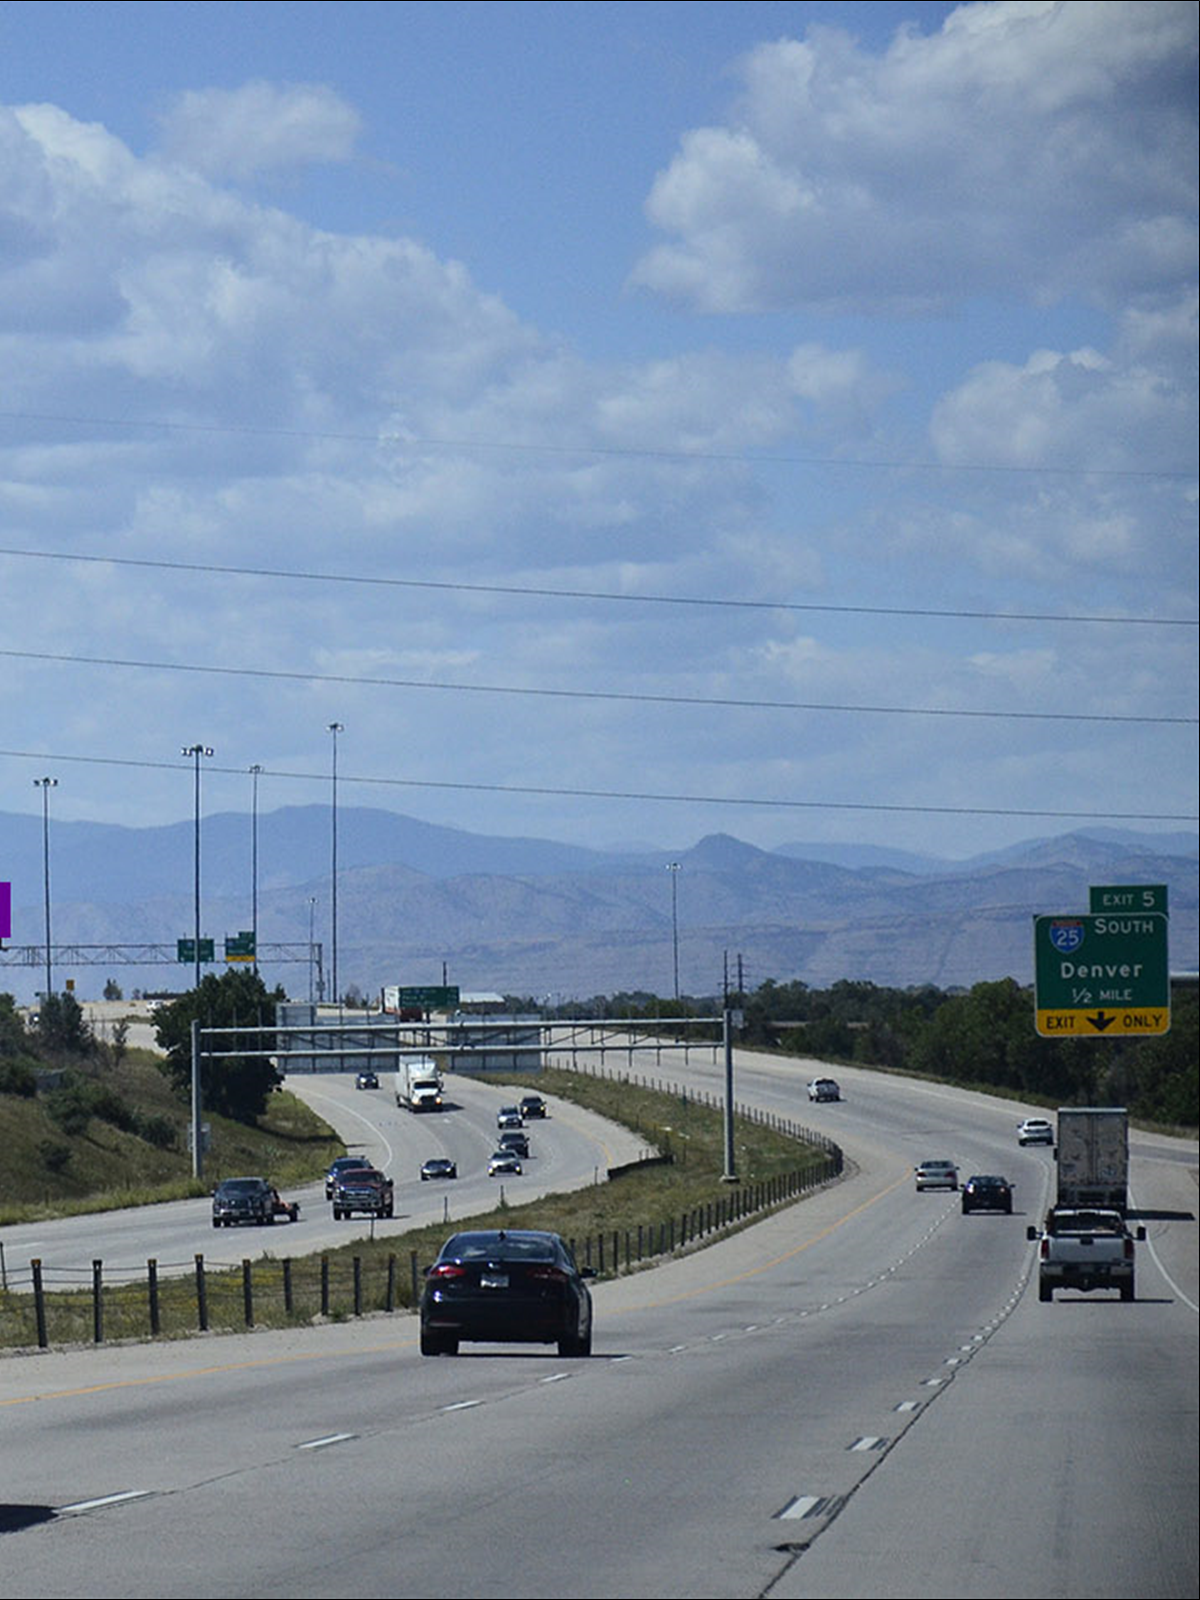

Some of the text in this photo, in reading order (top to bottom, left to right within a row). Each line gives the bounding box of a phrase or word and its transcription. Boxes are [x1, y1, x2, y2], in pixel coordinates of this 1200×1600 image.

[1103, 891, 1155, 907] EXIT 5
[1095, 918, 1154, 934] SOUTH
[1056, 929, 1080, 946] 25
[1060, 962, 1143, 979] Denver
[1099, 989, 1133, 1000] MILE
[1046, 1014, 1162, 1029] EXIT ONLY
